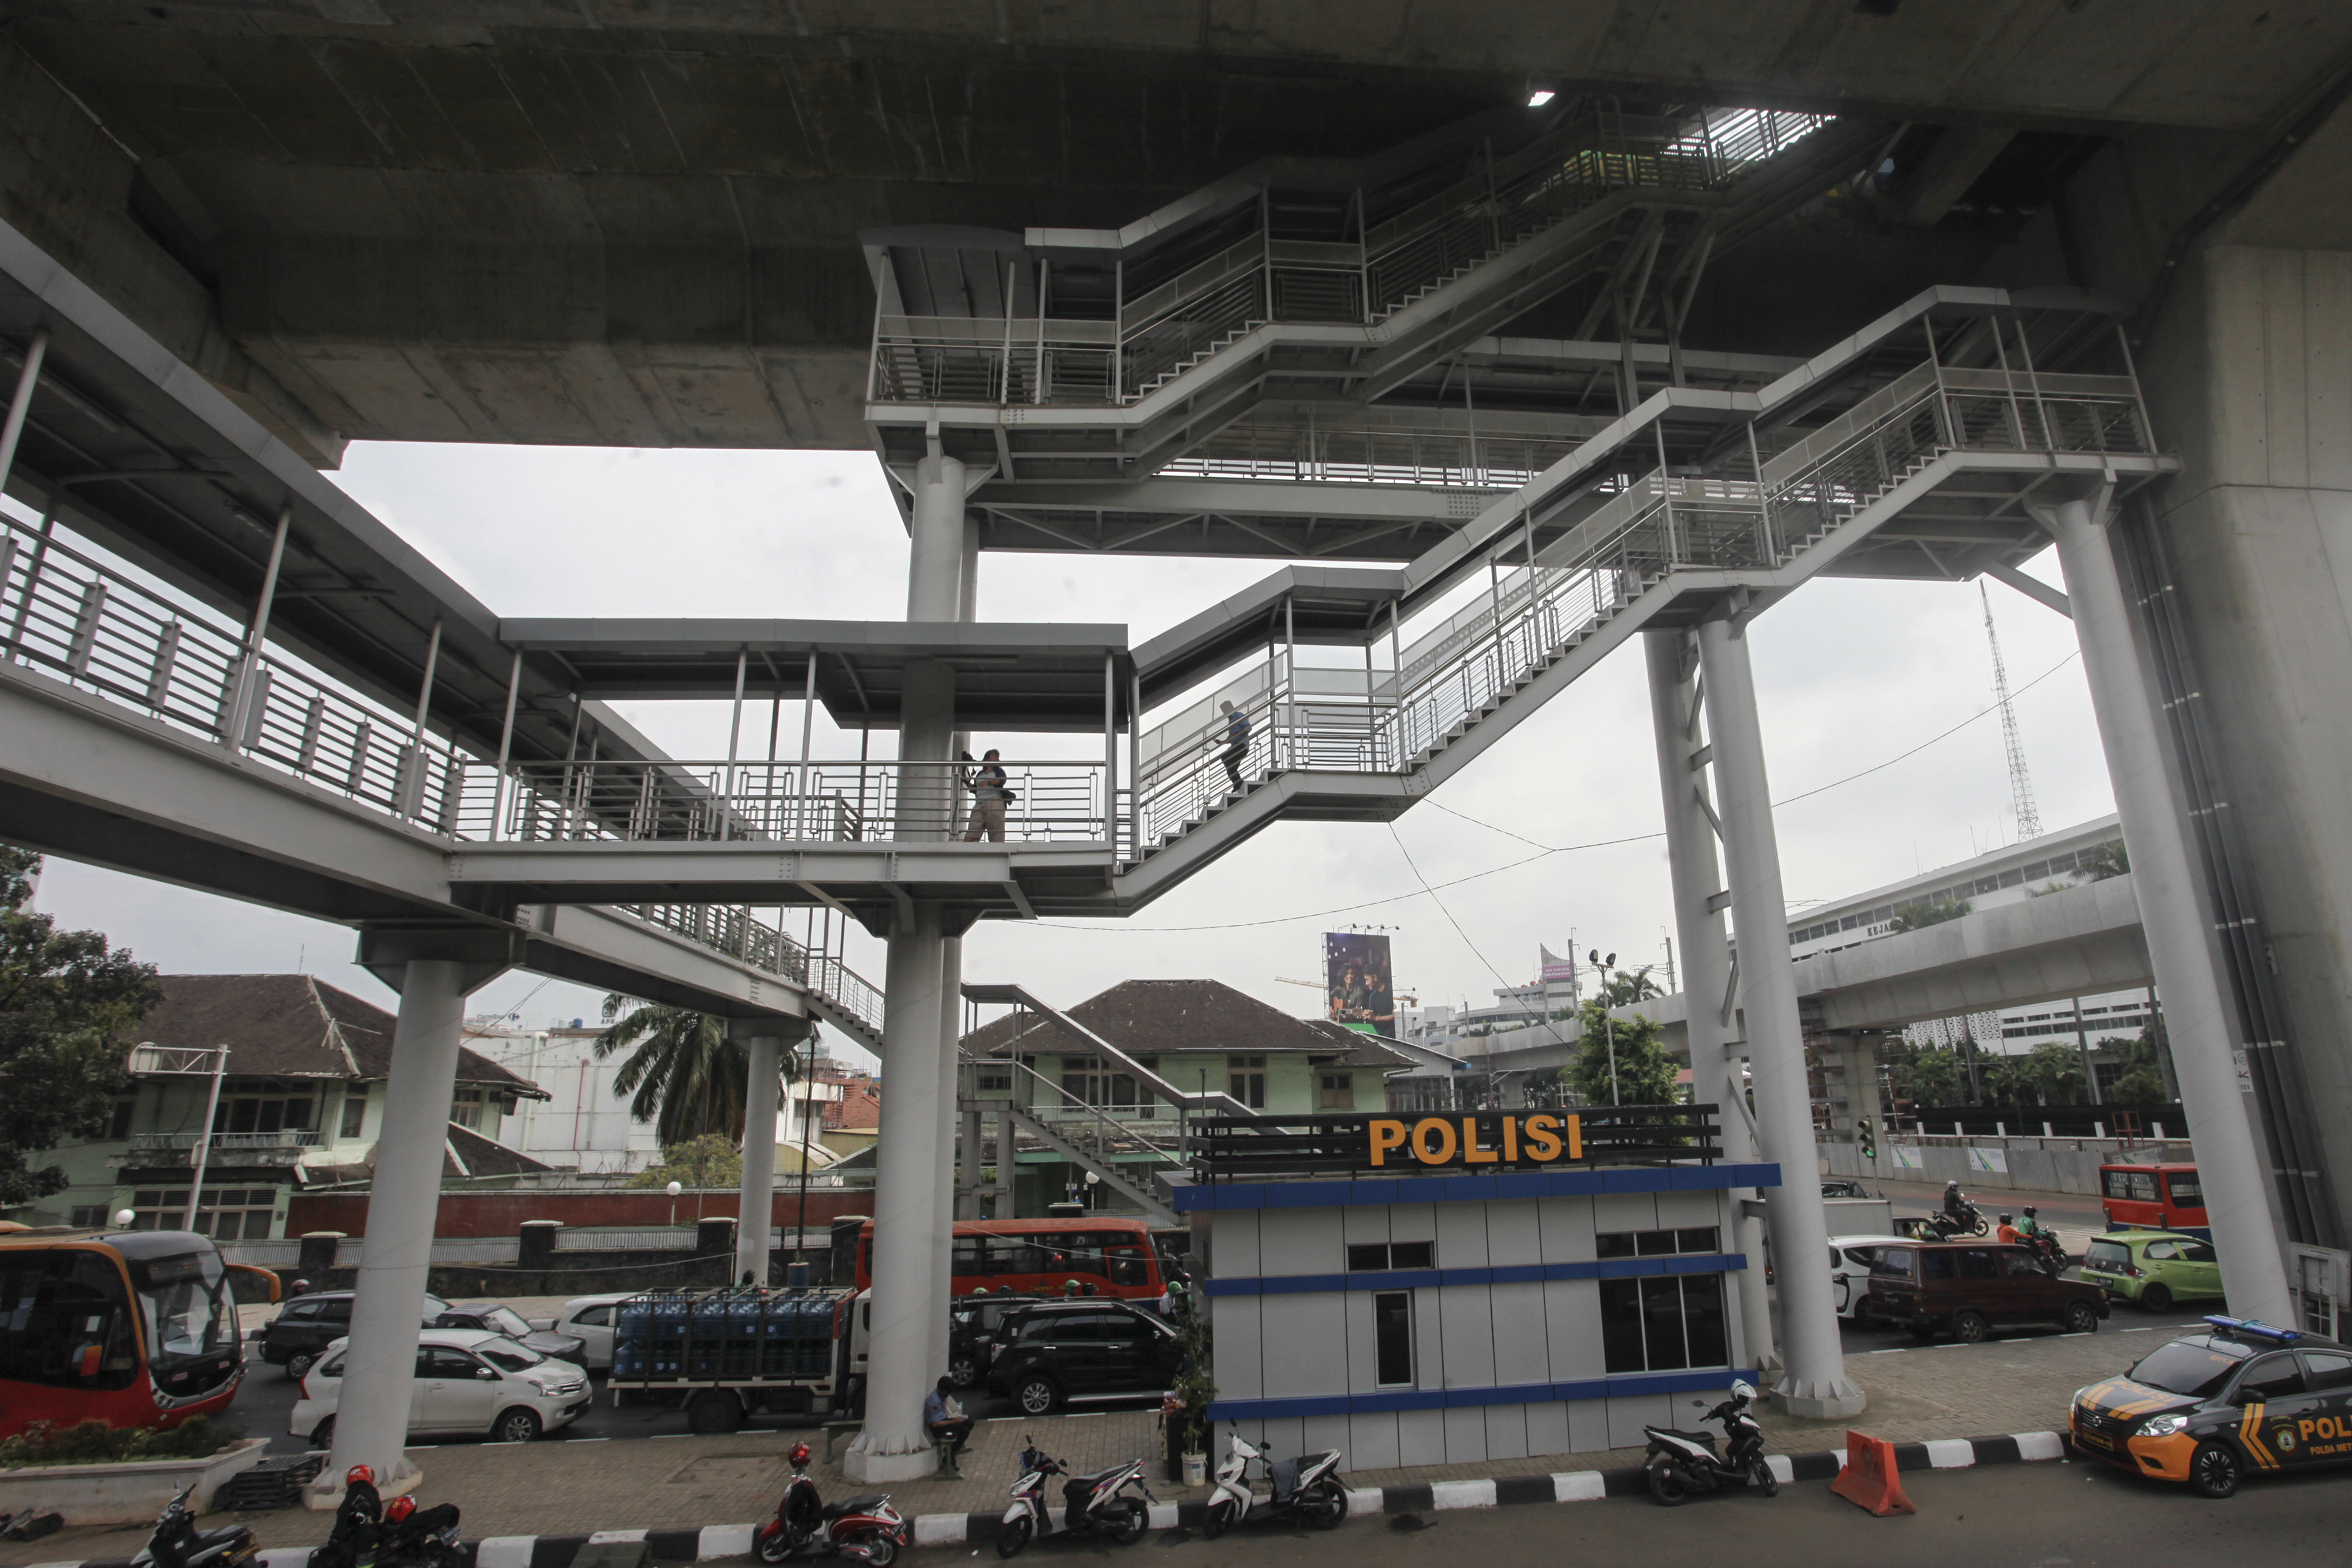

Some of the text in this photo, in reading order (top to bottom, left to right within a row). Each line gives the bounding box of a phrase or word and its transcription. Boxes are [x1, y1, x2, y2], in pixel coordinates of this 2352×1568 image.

[1369, 1114, 1582, 1166] POLISI
[2107, 1380, 2178, 1403] POLISI
[2310, 1445, 2336, 1455] POLDA
